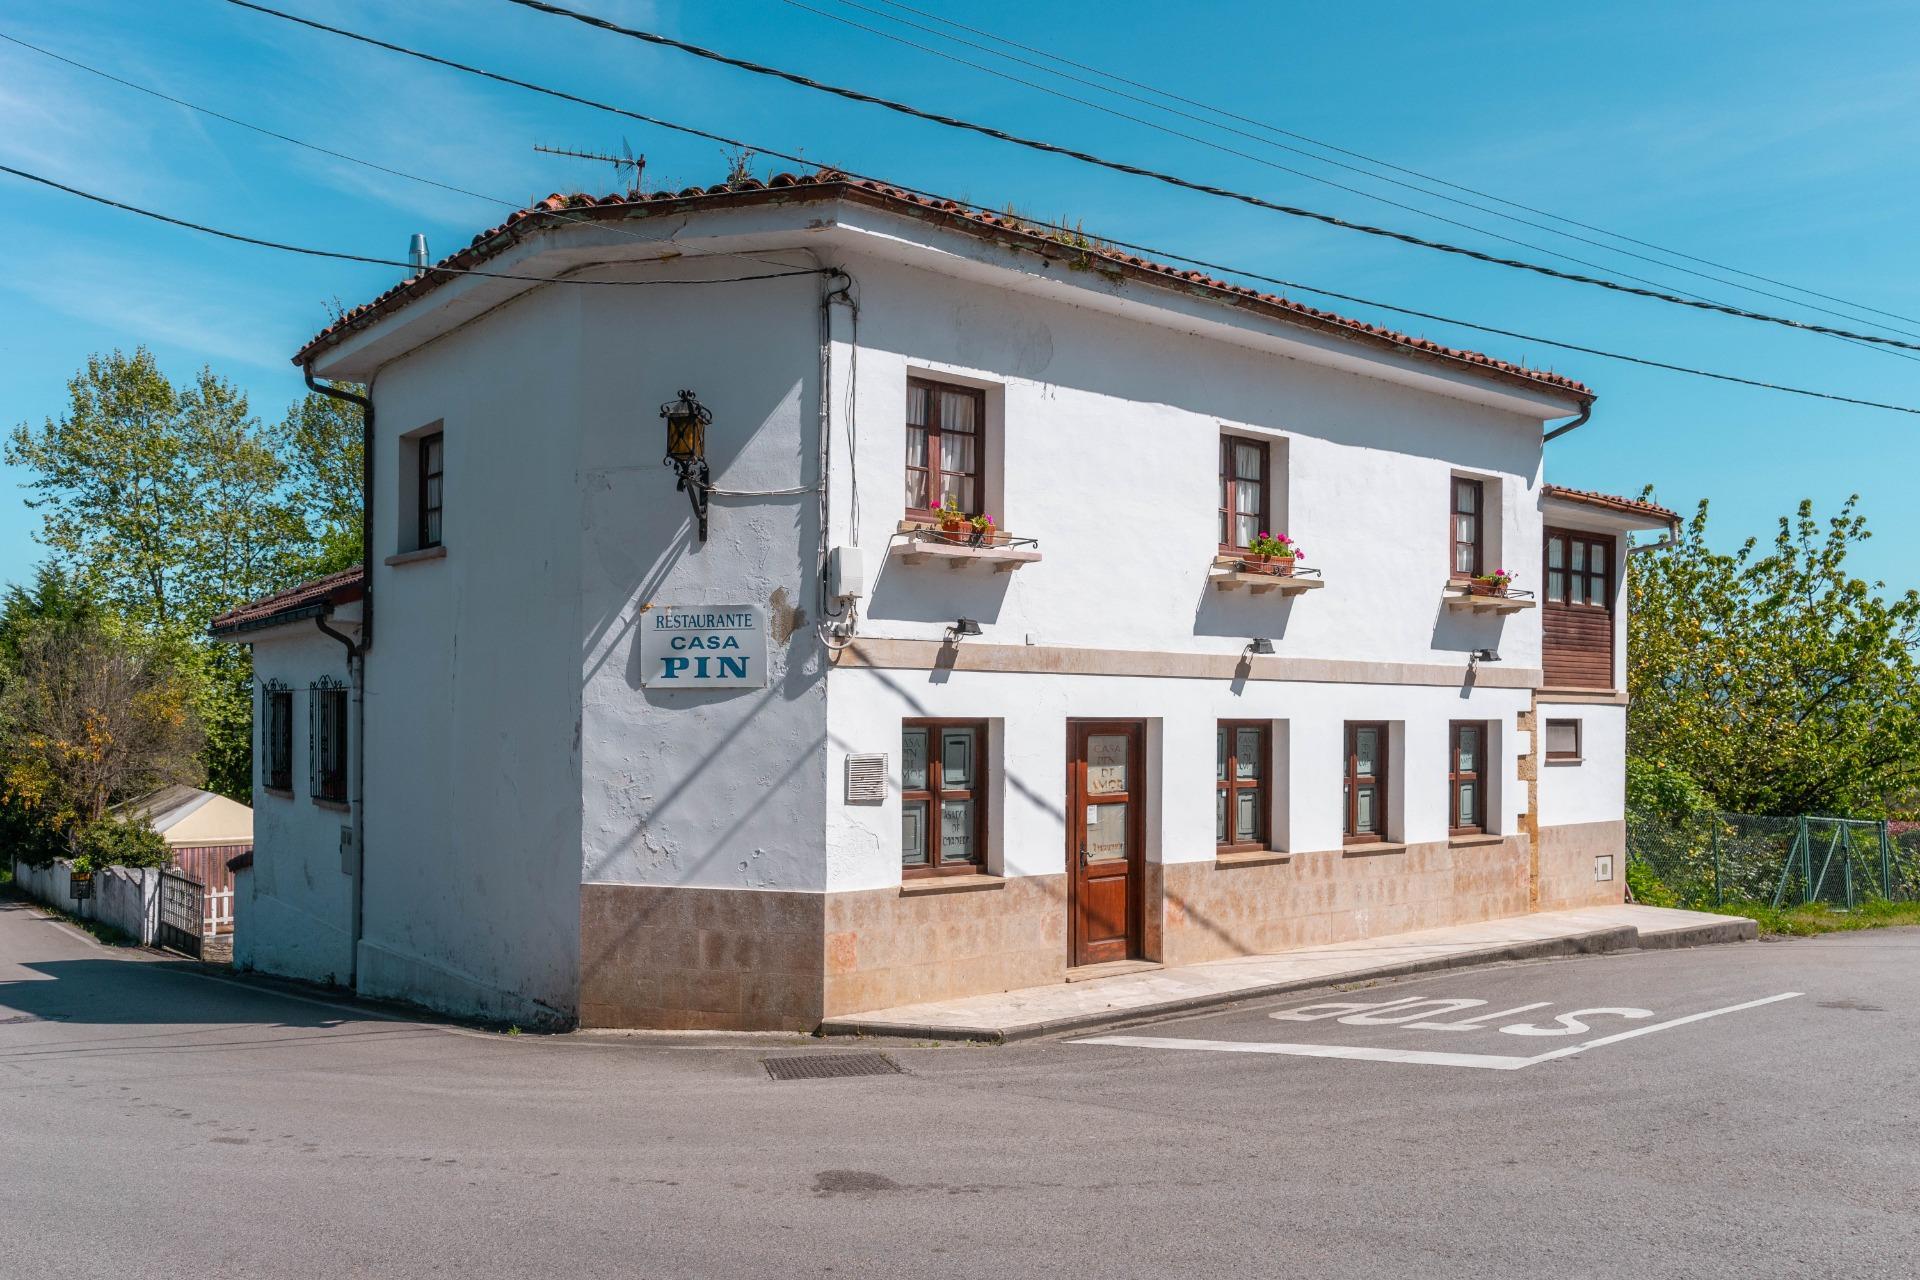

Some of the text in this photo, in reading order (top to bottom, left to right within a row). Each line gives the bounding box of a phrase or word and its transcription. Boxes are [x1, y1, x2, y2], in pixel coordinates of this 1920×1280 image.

[656, 613, 753, 629] RESTAURANTE
[670, 635, 740, 650] CASA
[660, 656, 750, 679] PIN
[1268, 996, 1654, 1036] STOP
